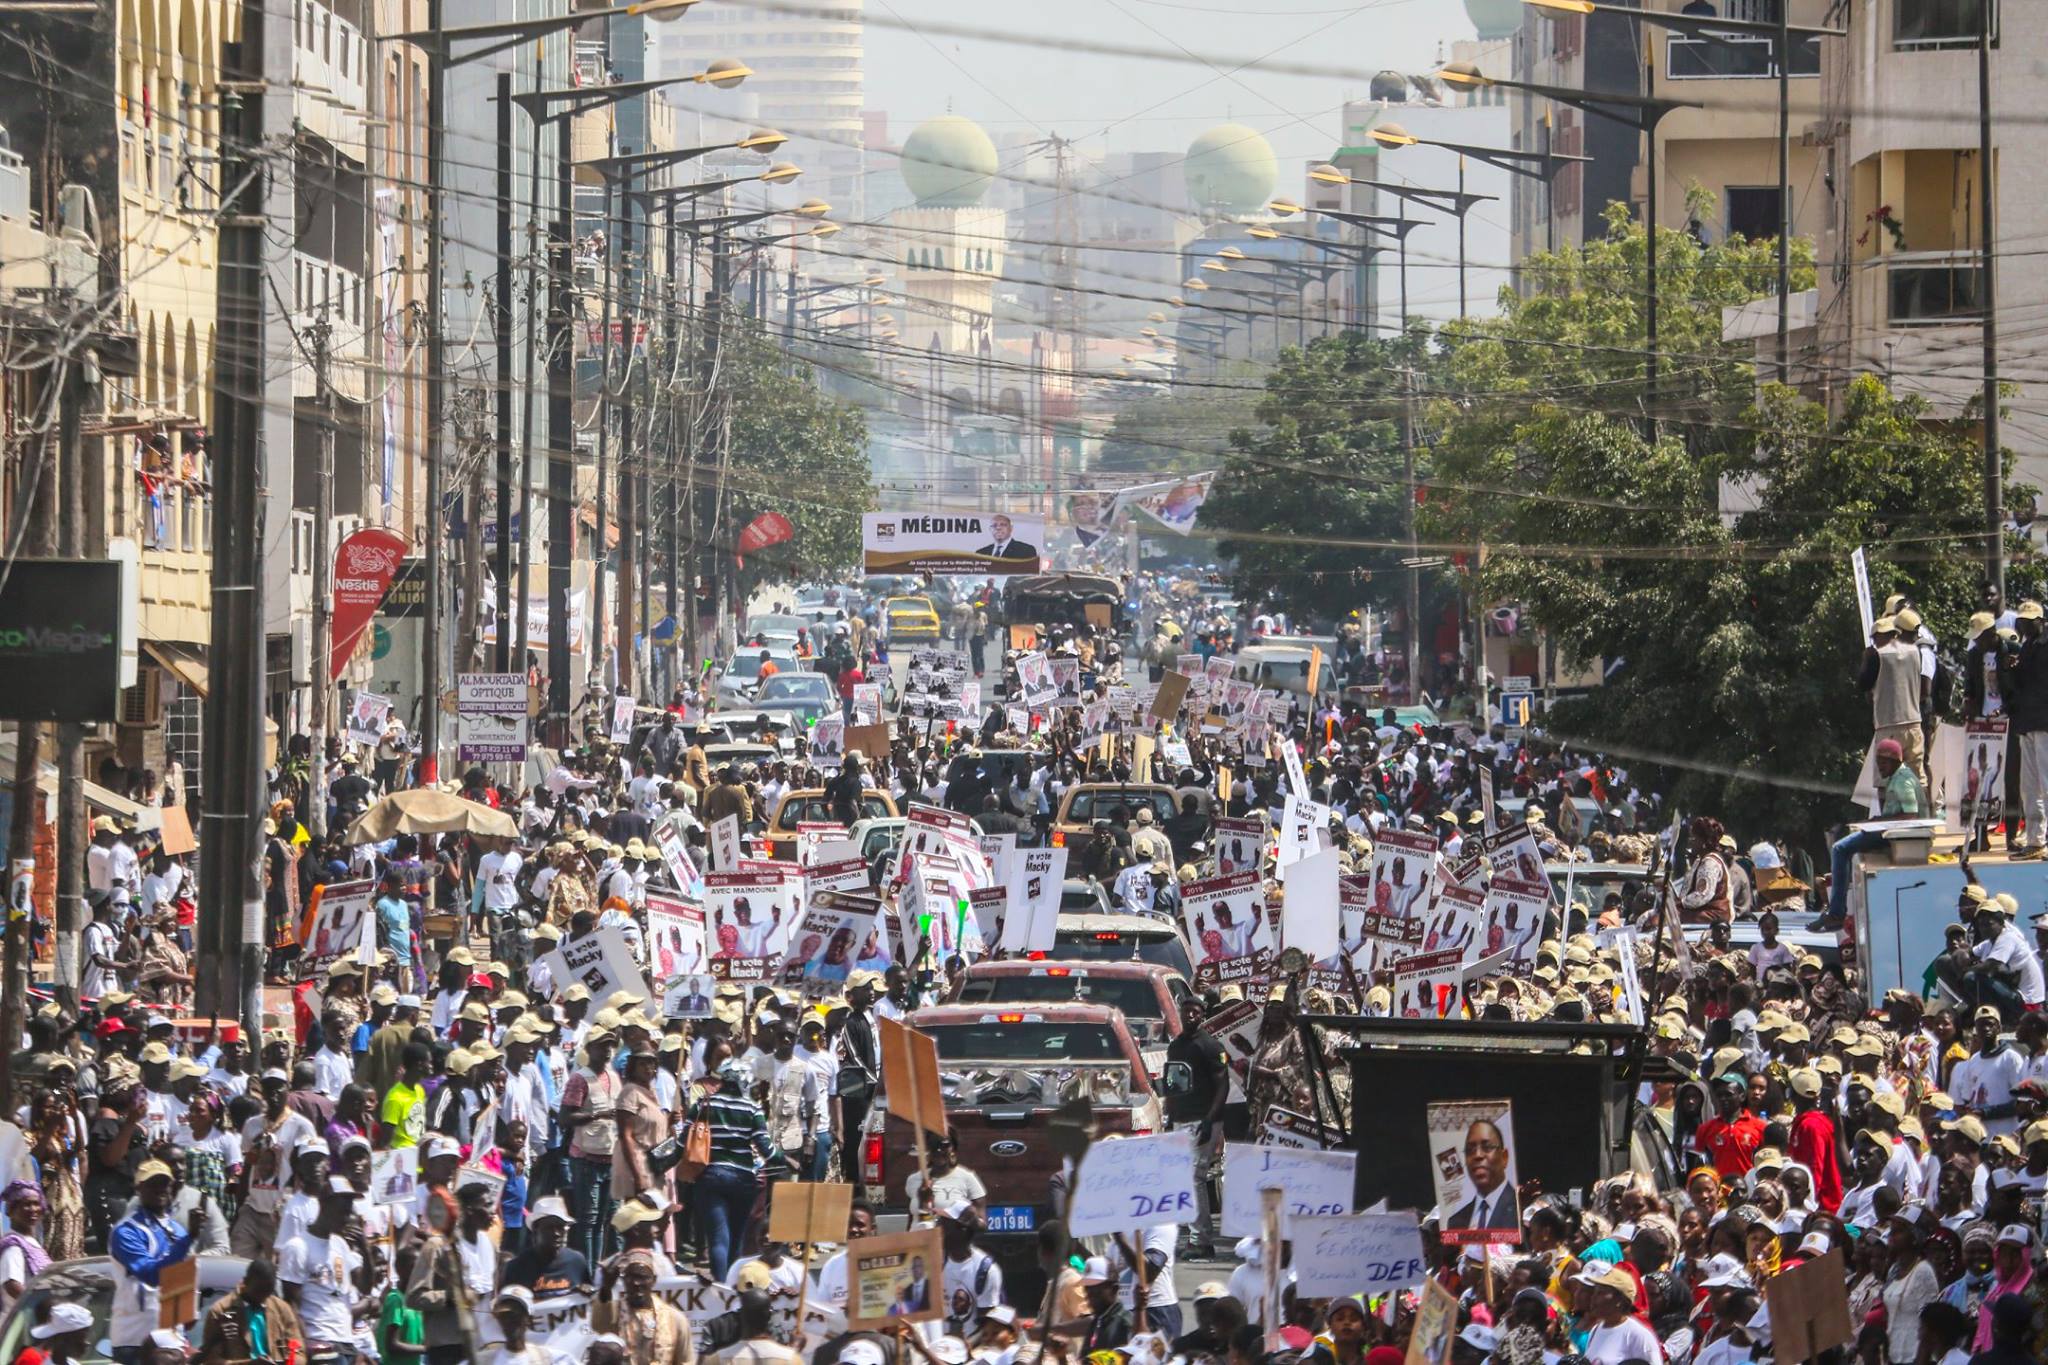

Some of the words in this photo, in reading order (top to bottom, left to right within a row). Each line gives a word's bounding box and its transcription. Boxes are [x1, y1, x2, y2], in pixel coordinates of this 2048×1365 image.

[902, 516, 981, 533] MÉDINA
[390, 581, 425, 591] STER
[471, 688, 514, 699] OPTIQUE
[1025, 861, 1051, 873] Macky
[733, 886, 777, 894] MAÏMOUNA
[1188, 895, 1208, 905] AVEC
[1210, 886, 1254, 901] MAÏMOUNA
[567, 949, 604, 971] Macky
[742, 959, 763, 967] vote
[1230, 956, 1251, 966] vote
[730, 968, 764, 979] Macky
[1220, 965, 1253, 980] Macky
[1321, 971, 1342, 981] vote
[1307, 978, 1341, 992] Mcky
[1129, 1191, 1194, 1217] DER
[1366, 1259, 1424, 1281] DER
